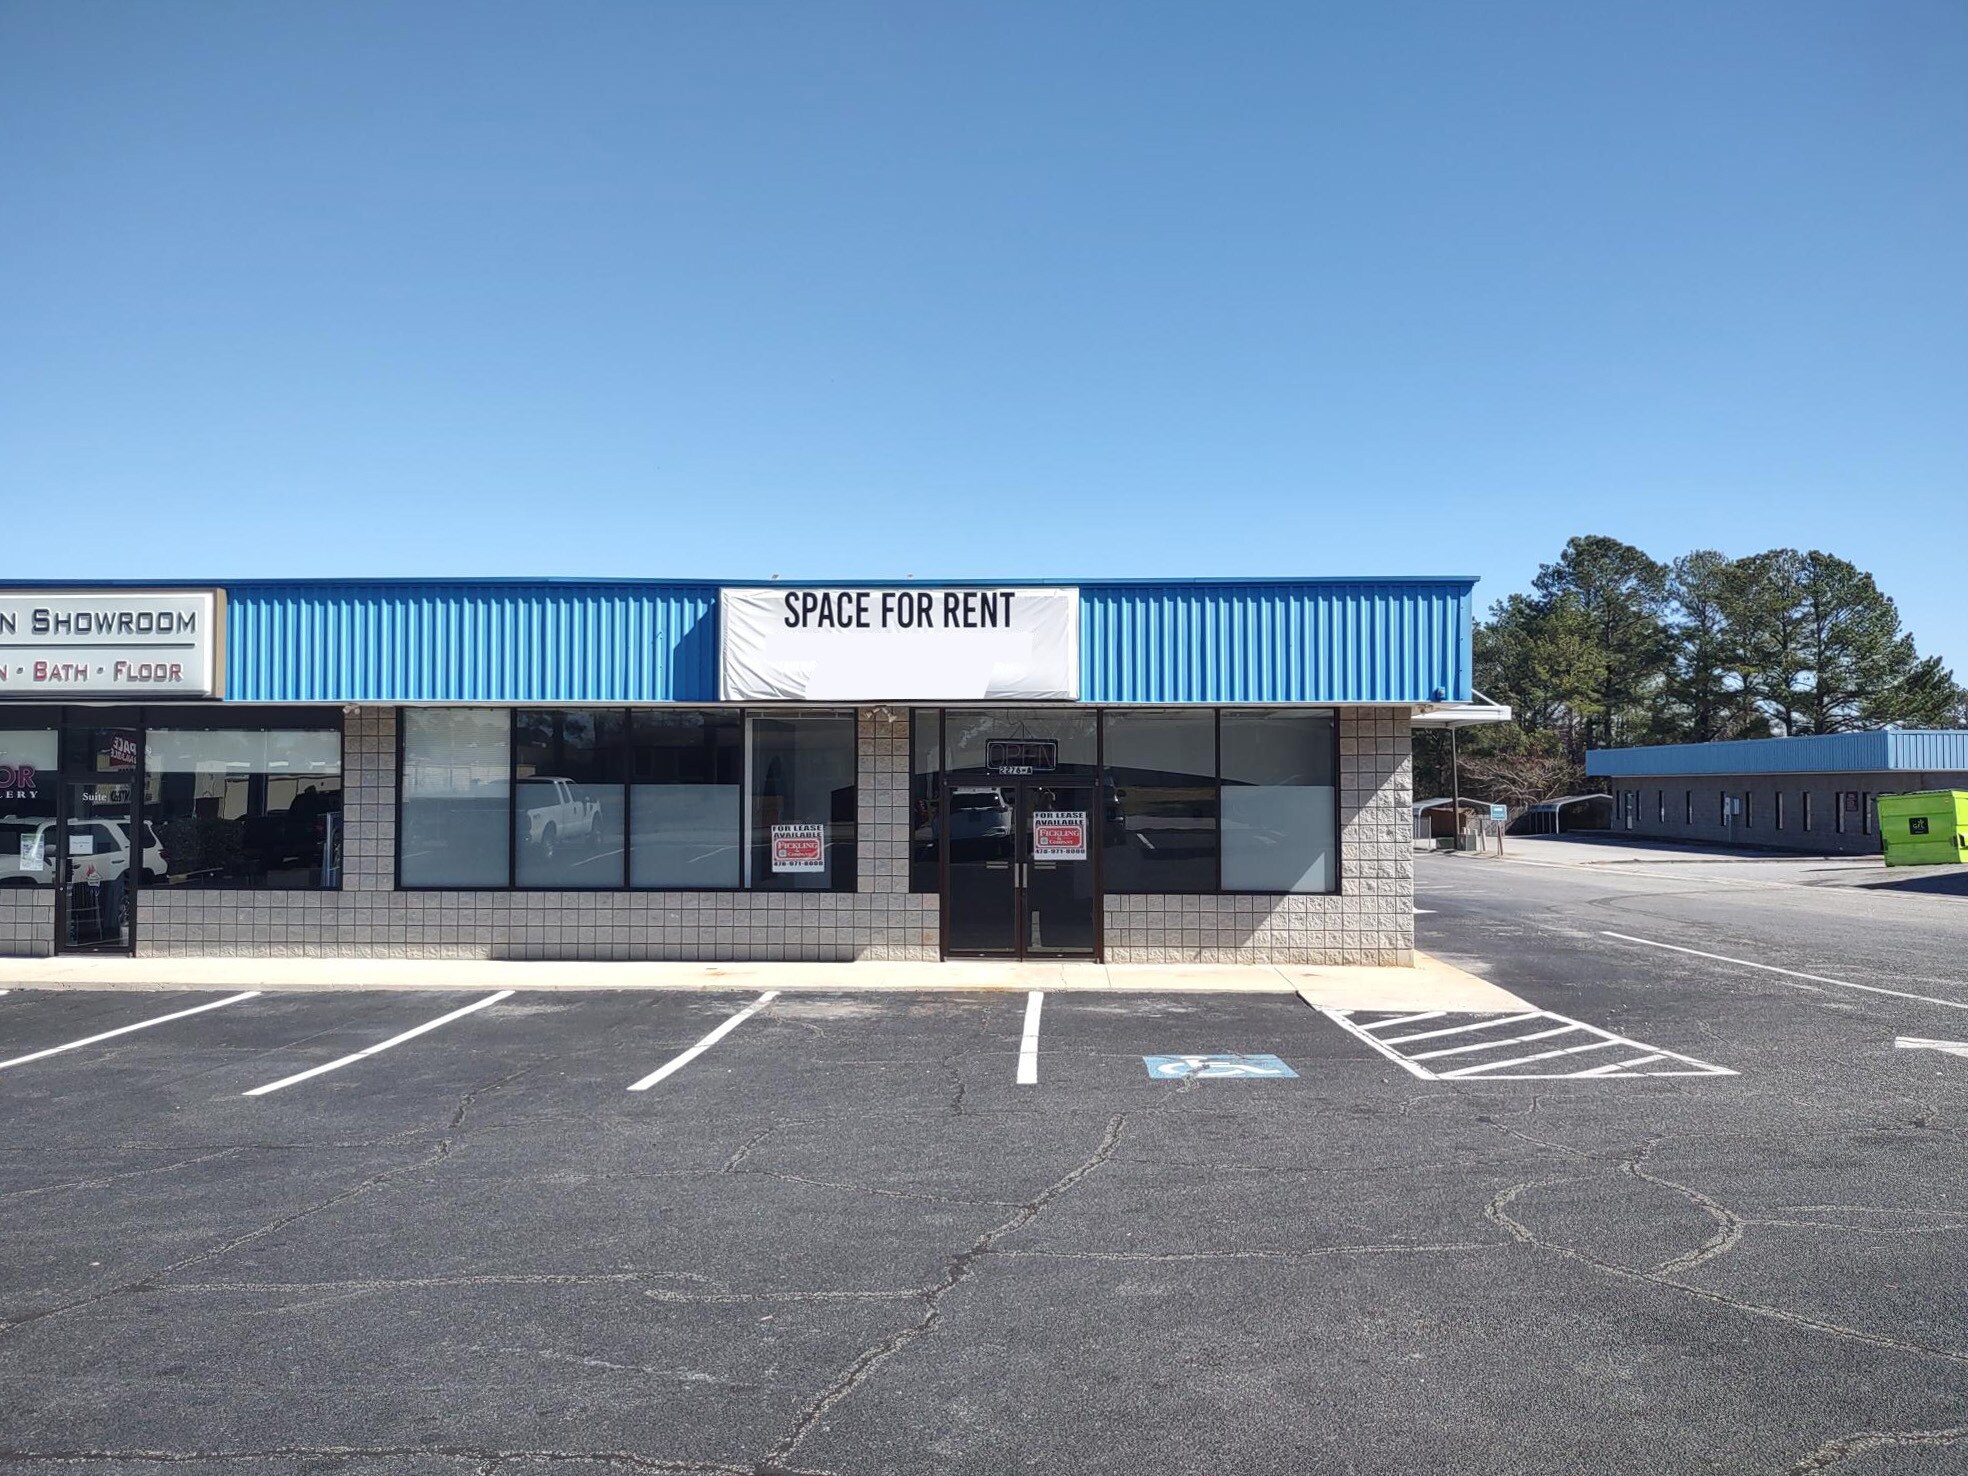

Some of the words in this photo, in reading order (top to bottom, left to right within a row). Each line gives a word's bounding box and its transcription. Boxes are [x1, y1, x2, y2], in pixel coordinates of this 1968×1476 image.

[784, 591, 870, 628] SPACE
[882, 591, 934, 628] FOR
[943, 591, 1015, 628] RENT
[32, 608, 197, 635] SHOWROOM
[33, 661, 89, 682] BATH
[113, 661, 184, 683] FLOOR
[989, 744, 1055, 766] OPEN
[82, 792, 107, 801] Suite
